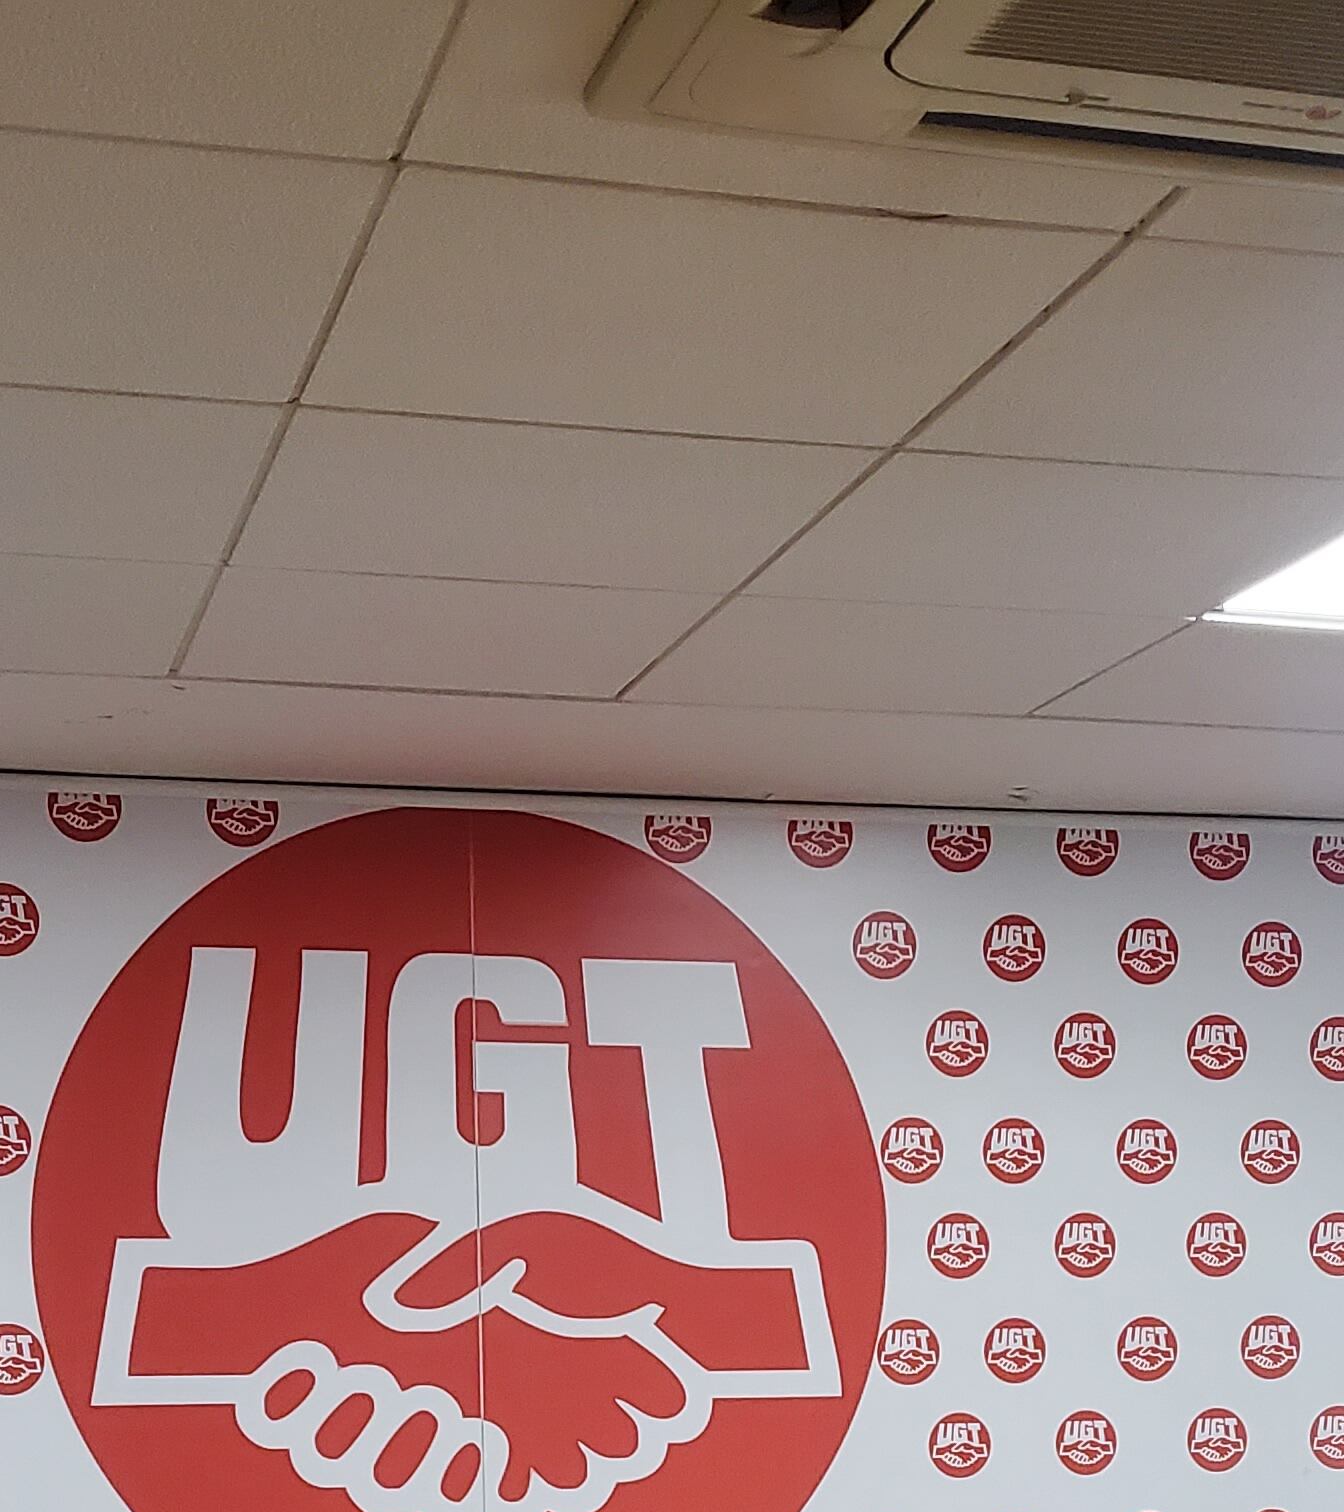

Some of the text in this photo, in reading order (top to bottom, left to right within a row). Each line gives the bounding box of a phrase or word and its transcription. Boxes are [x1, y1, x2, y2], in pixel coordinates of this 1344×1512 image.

[863, 922, 906, 947] UGT
[991, 925, 1035, 949] UGT
[1127, 928, 1170, 952] UGT
[1250, 932, 1293, 956] UGT
[935, 1020, 979, 1044] UGT
[1063, 1022, 1106, 1046] UGT
[1196, 1024, 1239, 1048] UGT
[155, 946, 751, 1241] UGT
[890, 1127, 933, 1151] UGT
[991, 1128, 1035, 1152] UGT
[1125, 1129, 1168, 1152] UGT
[1249, 1130, 1291, 1153] UGT
[936, 1223, 980, 1247] UGT
[1063, 1222, 1106, 1246] UGT
[1195, 1222, 1238, 1245] UGT
[887, 1329, 930, 1353] UGT
[992, 1328, 1036, 1352] UGT
[1125, 1326, 1168, 1349] UGT
[1248, 1326, 1291, 1349] UGT
[937, 1422, 981, 1446] UGT
[1065, 1420, 1108, 1444] UGT
[1196, 1418, 1239, 1441] UGT
